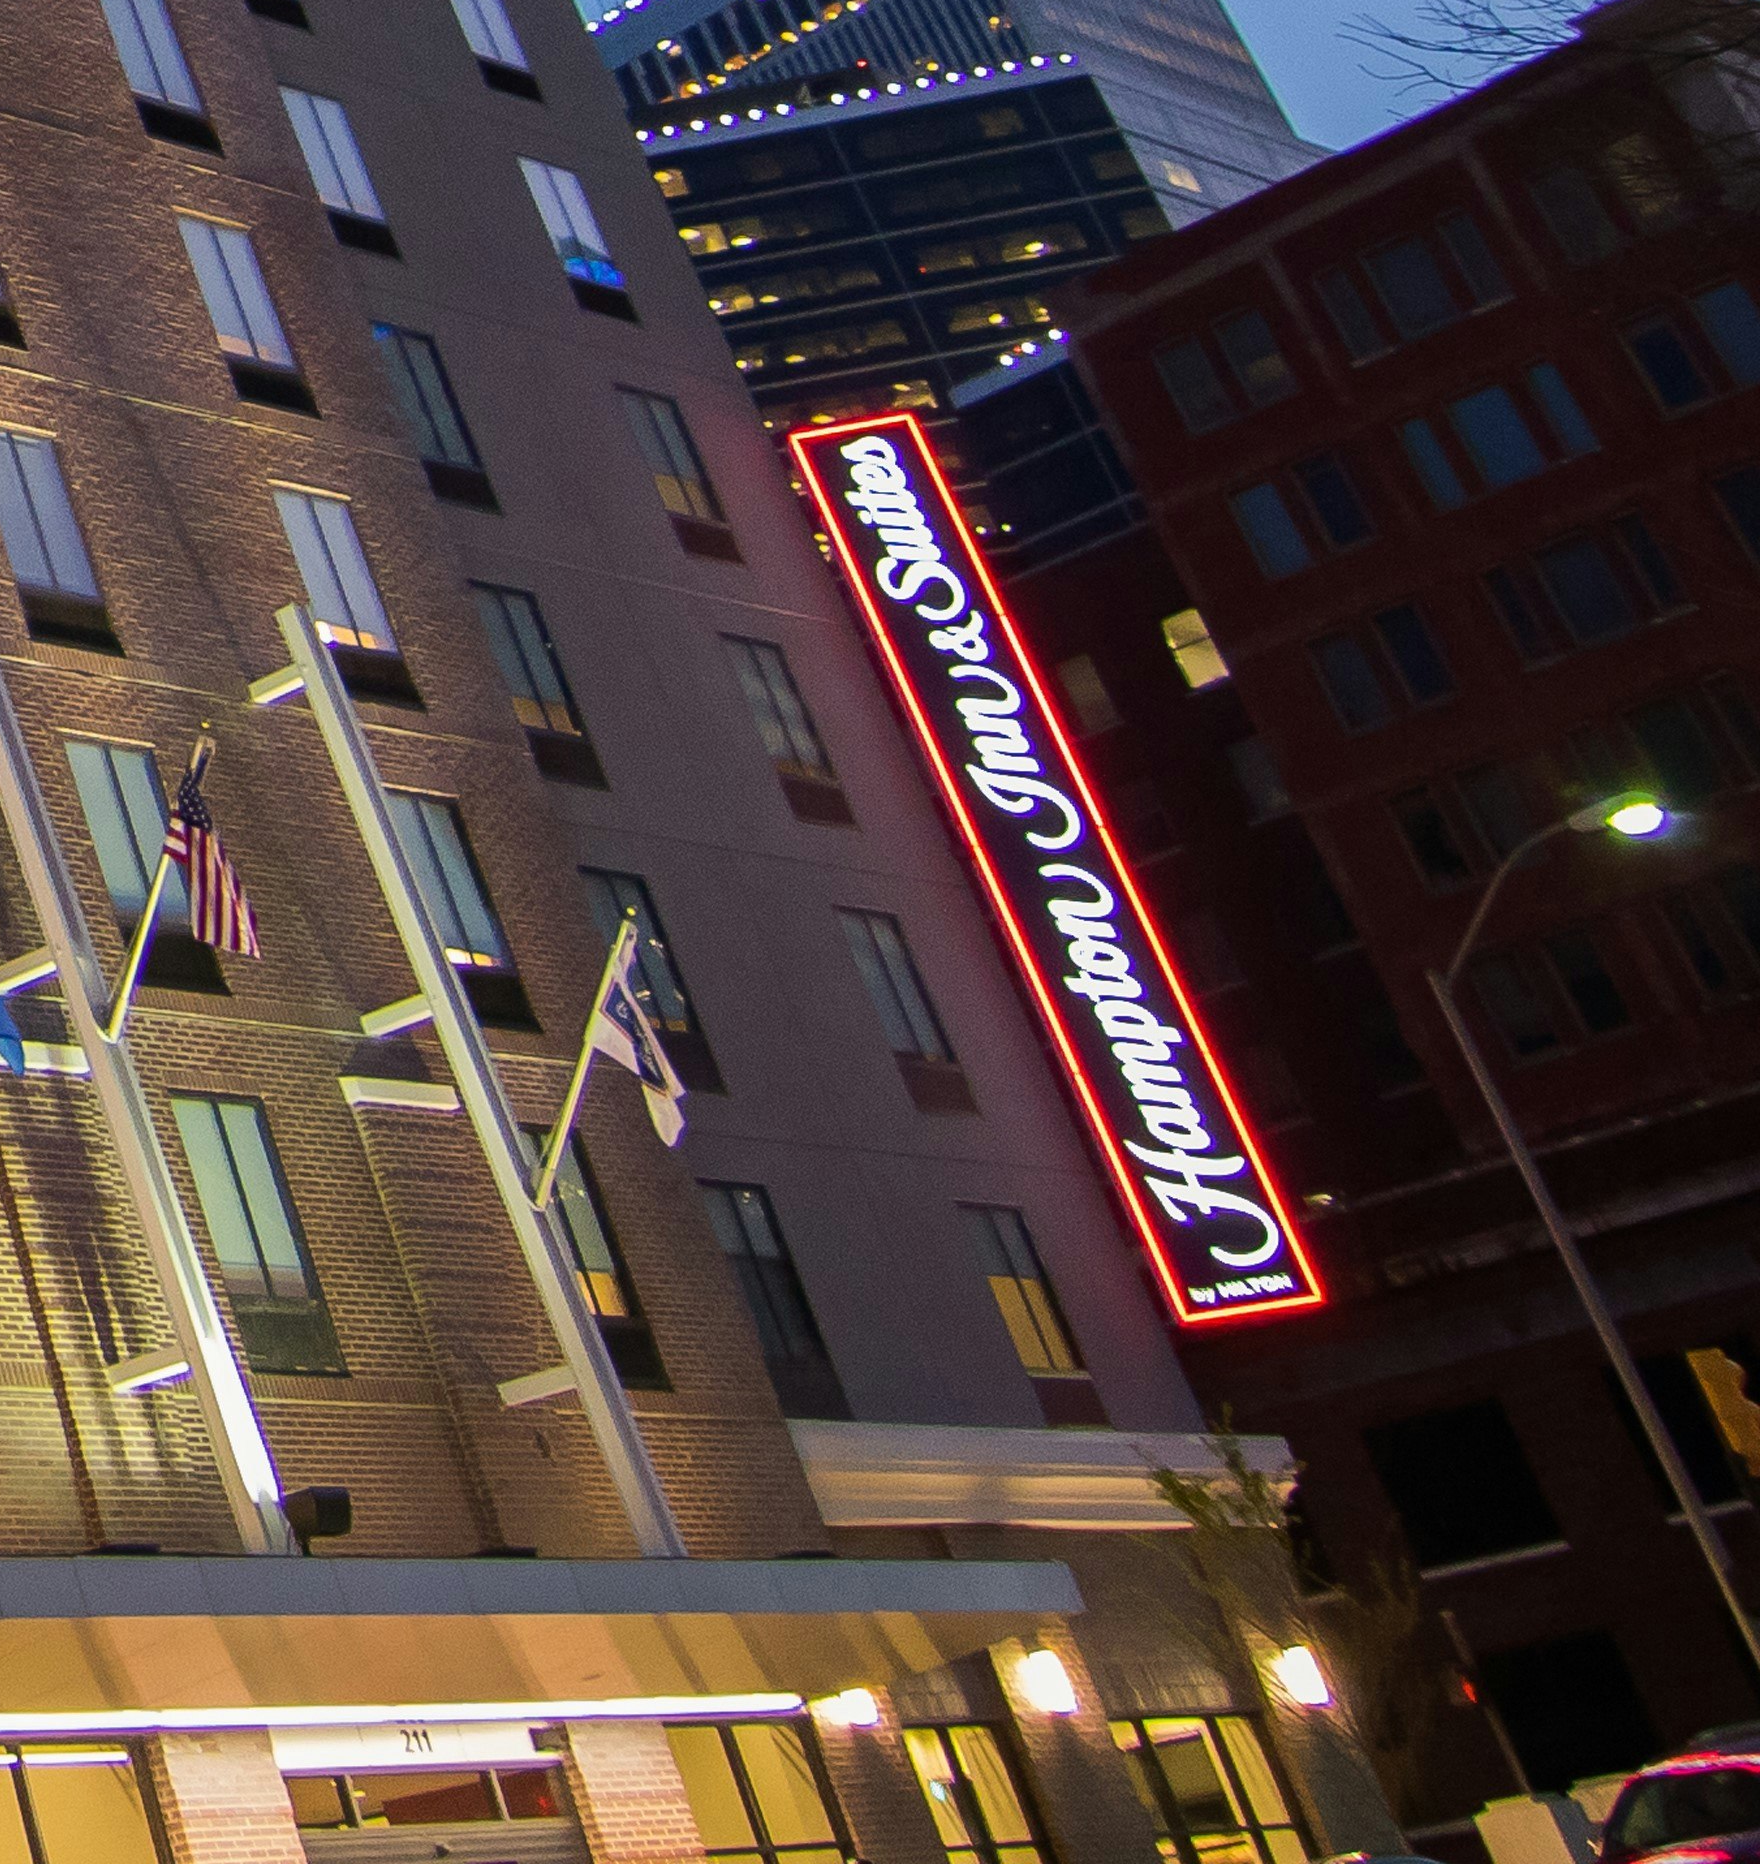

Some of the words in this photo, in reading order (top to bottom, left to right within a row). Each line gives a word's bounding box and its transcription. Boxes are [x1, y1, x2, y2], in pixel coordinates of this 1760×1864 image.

[840, 435, 966, 622] Suites
[928, 609, 990, 663] &
[948, 664, 1082, 850] Inn
[1038, 863, 1280, 1267] Hampton
[1188, 1287, 1216, 1304] by
[1215, 1272, 1294, 1299] HILTON
[399, 1729, 433, 1753] 211
